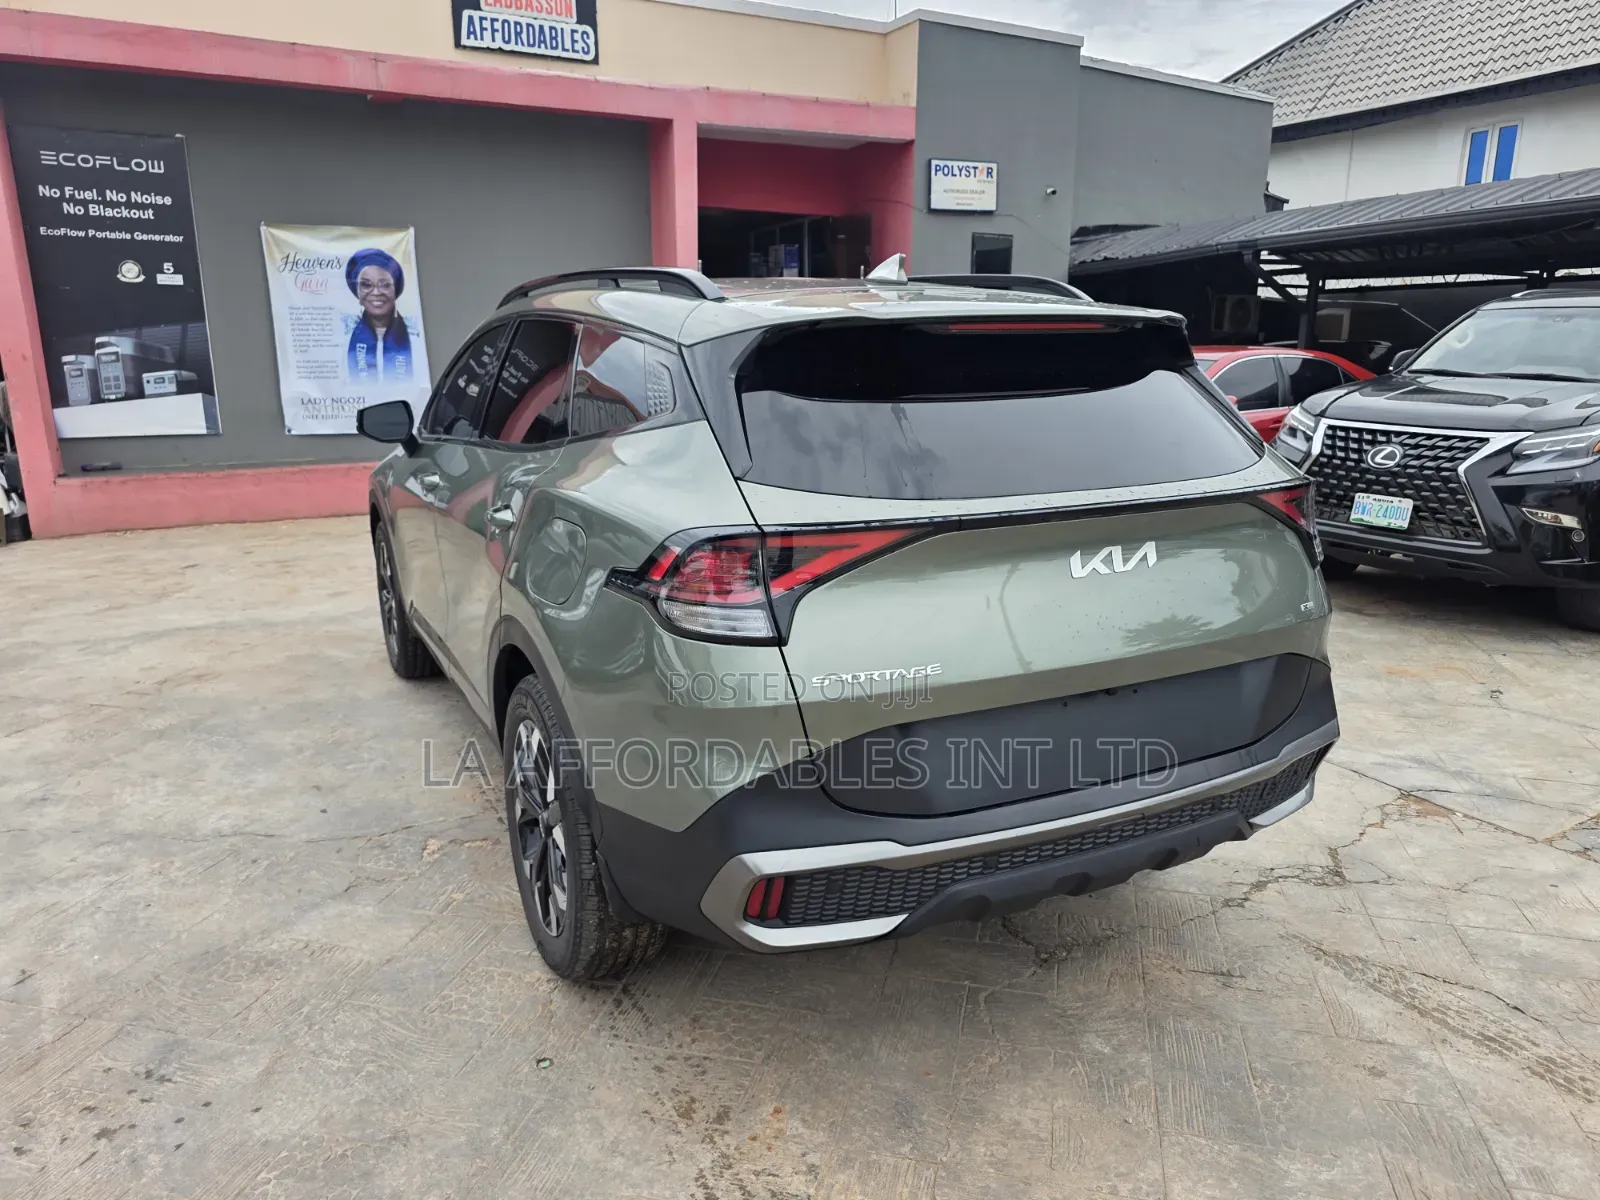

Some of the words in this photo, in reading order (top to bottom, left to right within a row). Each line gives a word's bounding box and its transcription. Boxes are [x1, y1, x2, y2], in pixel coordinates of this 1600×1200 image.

[466, 14, 592, 56] AFFORDABLES
[40, 150, 165, 174] ECOFLOW
[38, 184, 60, 198] No
[64, 186, 102, 201] Fuel.
[105, 189, 127, 202] No
[130, 191, 173, 205] Noise
[62, 202, 84, 215] No
[88, 204, 155, 219] Blackout
[39, 226, 86, 238] EcoFlow
[88, 229, 132, 240] Portable
[133, 231, 184, 243] Generator
[163, 262, 174, 274] 5
[278, 252, 343, 275] Heaven's
[294, 272, 329, 295] Gain
[301, 397, 328, 405] LADY
[331, 396, 366, 405] NGOZI
[1069, 541, 1158, 579] KIA
[811, 662, 943, 688] SPORTAGE
